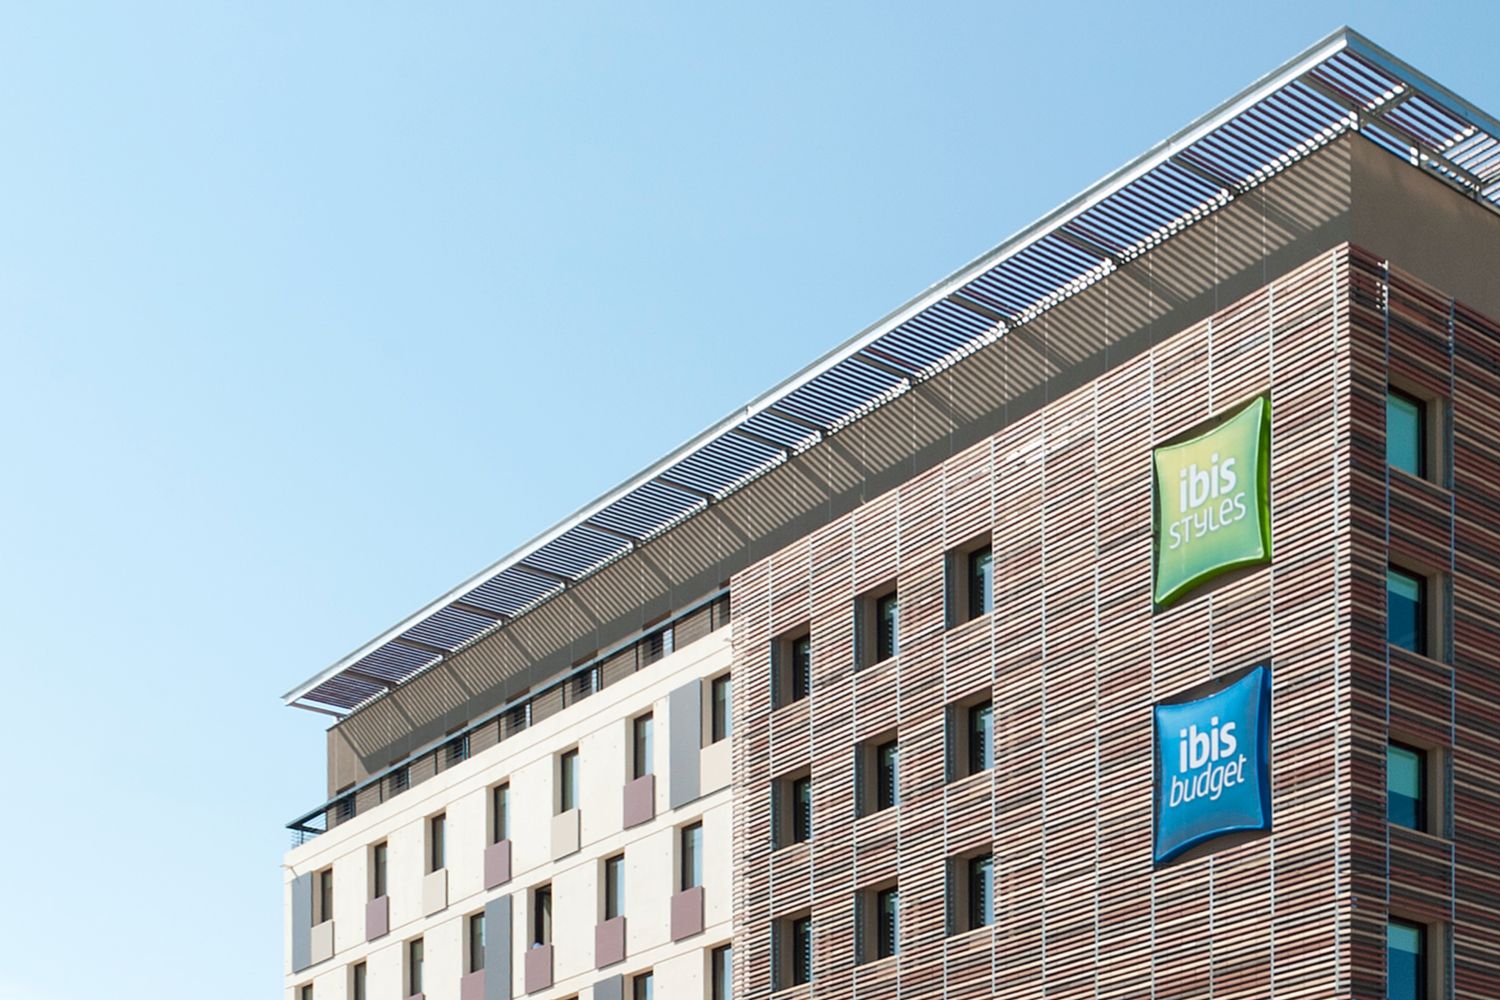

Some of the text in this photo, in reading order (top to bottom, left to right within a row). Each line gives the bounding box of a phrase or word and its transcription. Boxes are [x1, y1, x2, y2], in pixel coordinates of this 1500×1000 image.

[1180, 452, 1236, 513] ibis
[1180, 716, 1237, 773] ibis
[1169, 753, 1247, 807] budget
